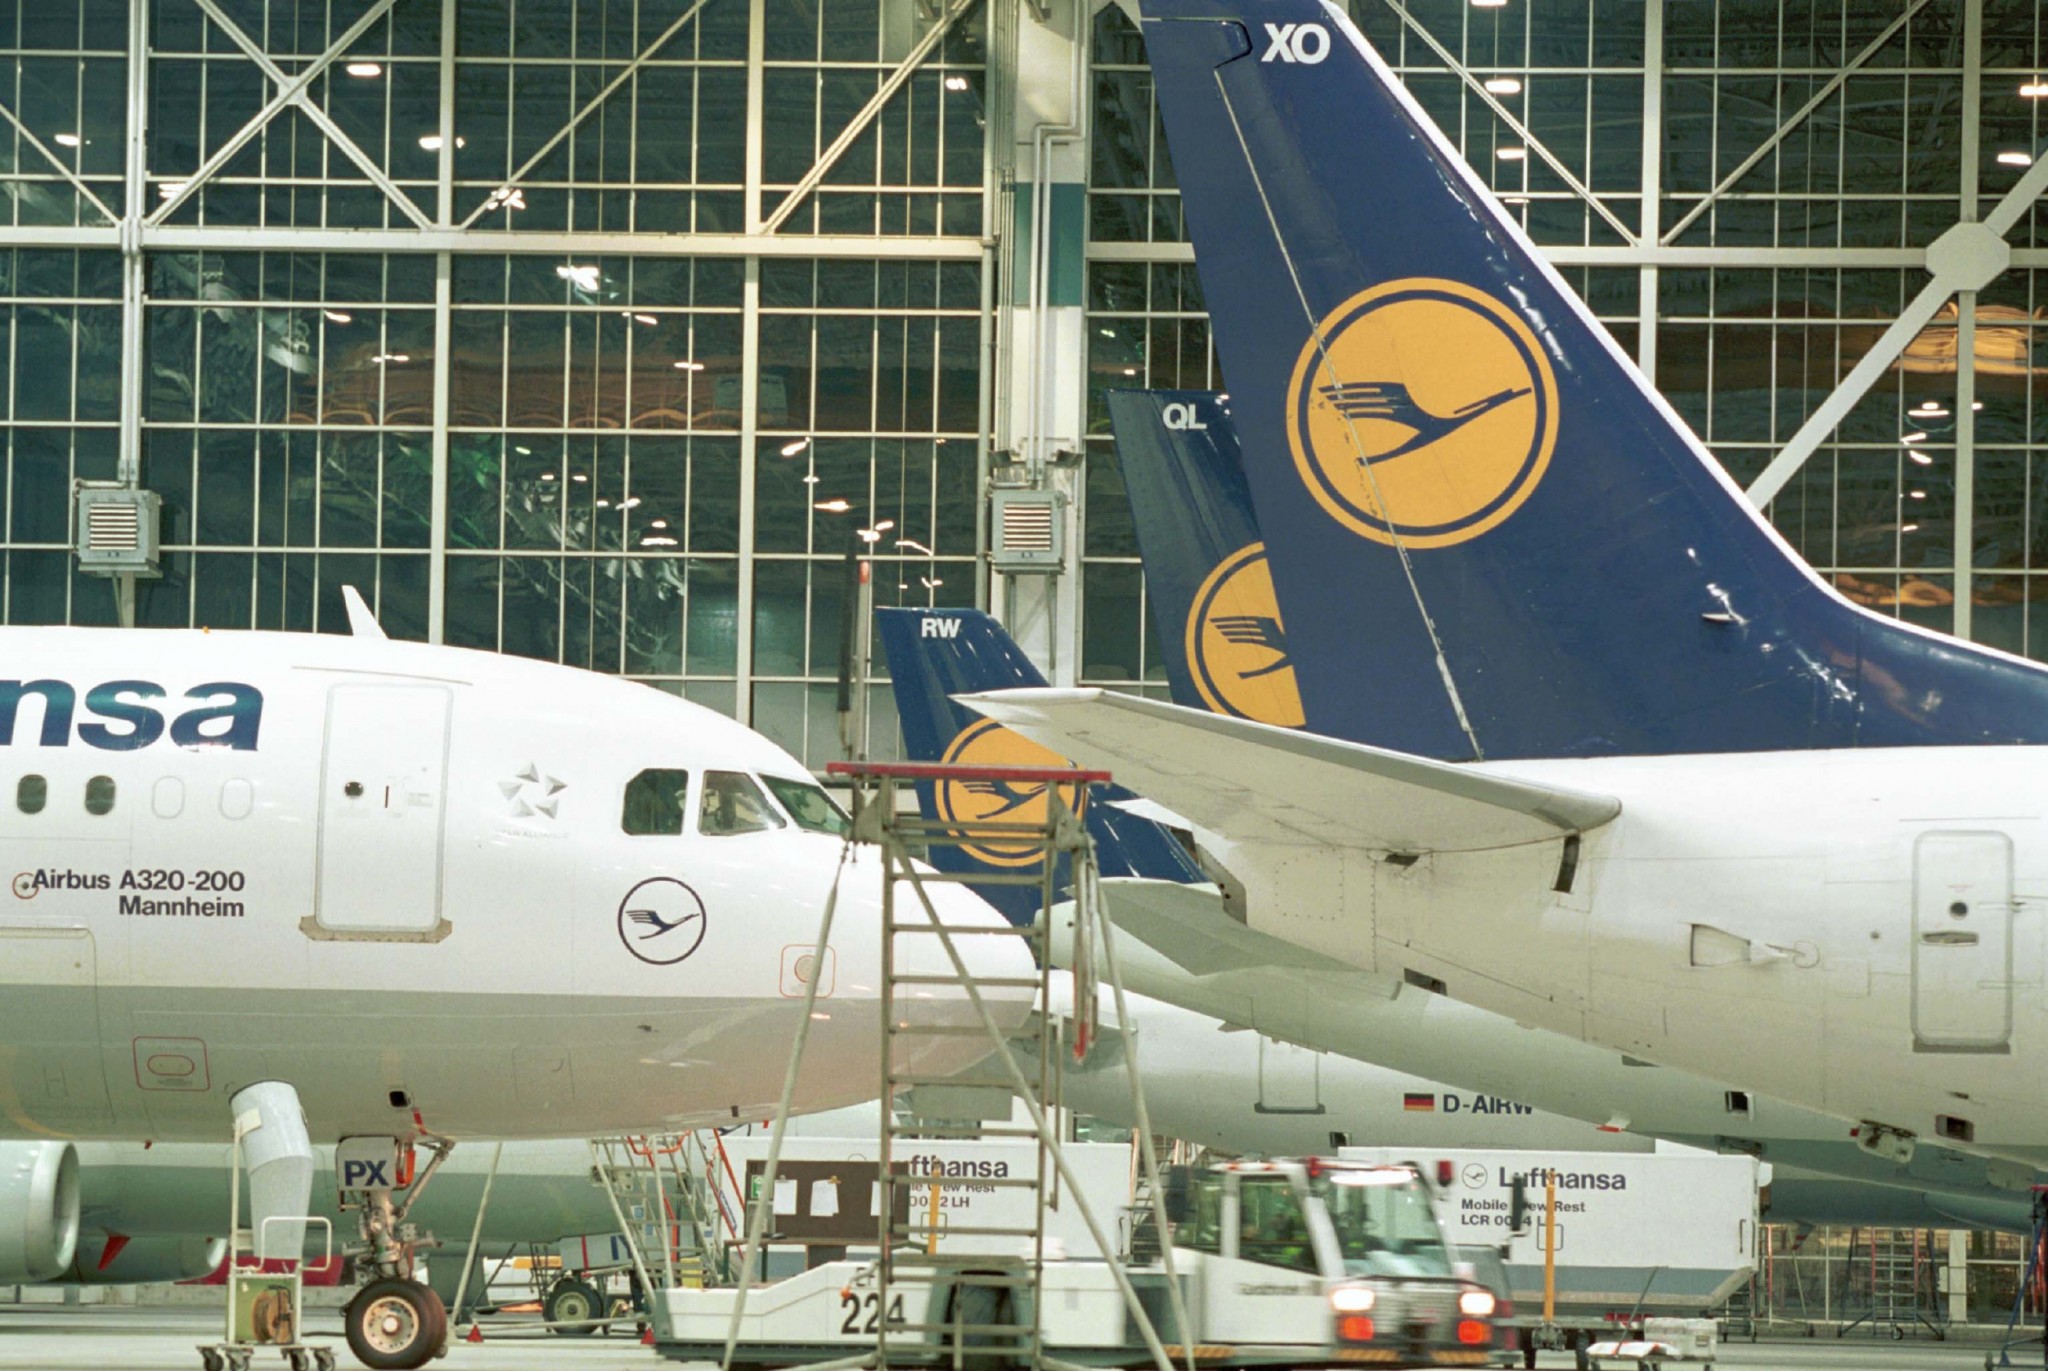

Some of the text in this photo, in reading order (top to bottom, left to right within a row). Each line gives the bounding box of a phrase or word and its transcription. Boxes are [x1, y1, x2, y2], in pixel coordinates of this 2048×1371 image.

[1261, 23, 1331, 65] XO
[1162, 402, 1208, 431] QL
[921, 617, 962, 638] RW
[31, 868, 246, 892] Airbus A320-200
[118, 895, 245, 917] Mannheim
[344, 1160, 390, 1187] PX
[909, 1154, 1009, 1178] fthansa
[909, 1195, 970, 1208] 002 LH
[1461, 1198, 1508, 1211] Mobile
[1554, 1200, 1586, 1213] Rest
[1461, 1214, 1490, 1226] LCR
[1494, 1215, 1533, 1227] 004
[840, 1292, 906, 1335] 224
